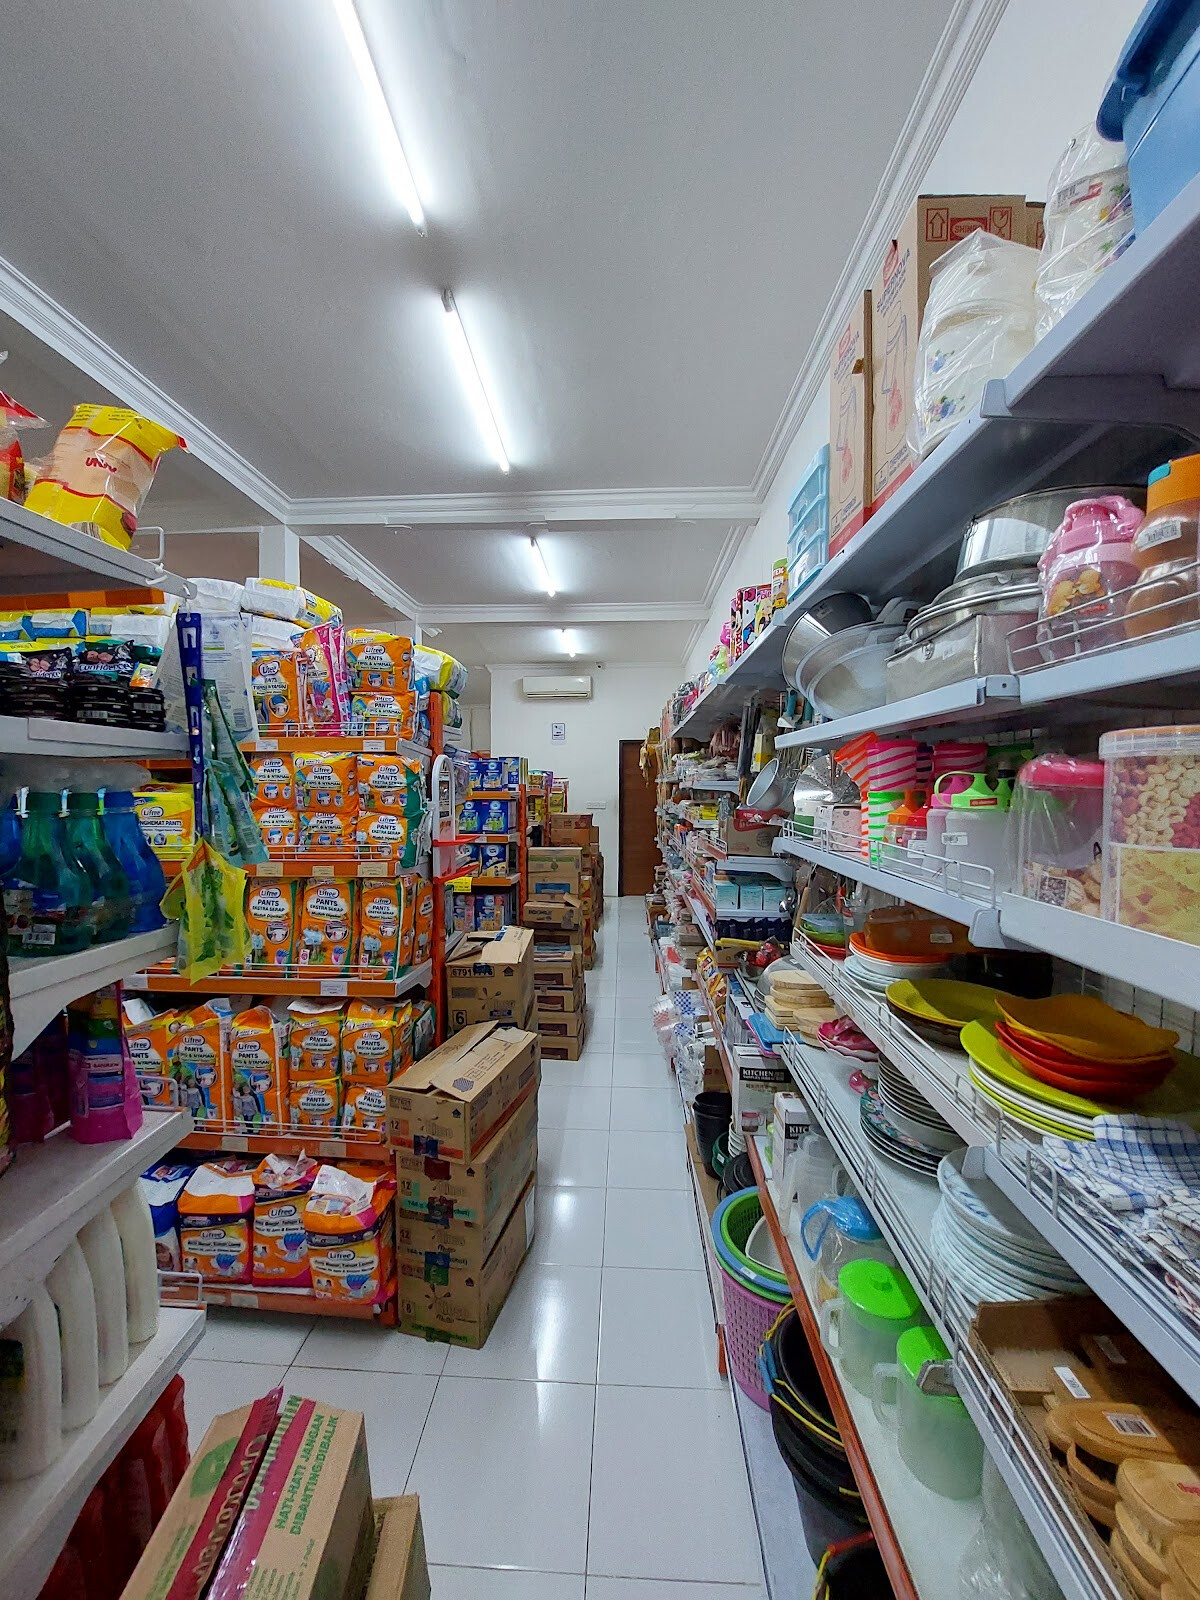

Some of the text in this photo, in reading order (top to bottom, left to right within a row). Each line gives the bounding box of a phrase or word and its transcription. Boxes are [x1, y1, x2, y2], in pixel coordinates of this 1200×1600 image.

[378, 816, 397, 824] Lifree
[315, 898, 338, 906] PANTS
[455, 1011, 465, 1025] 6
[184, 1036, 202, 1044] Lifree
[743, 1069, 774, 1077] KITCHEN
[363, 1096, 382, 1104] PANTS
[391, 1120, 399, 1129] 12
[271, 1209, 293, 1217] Lifree
[300, 1413, 325, 1462] JANGAN
